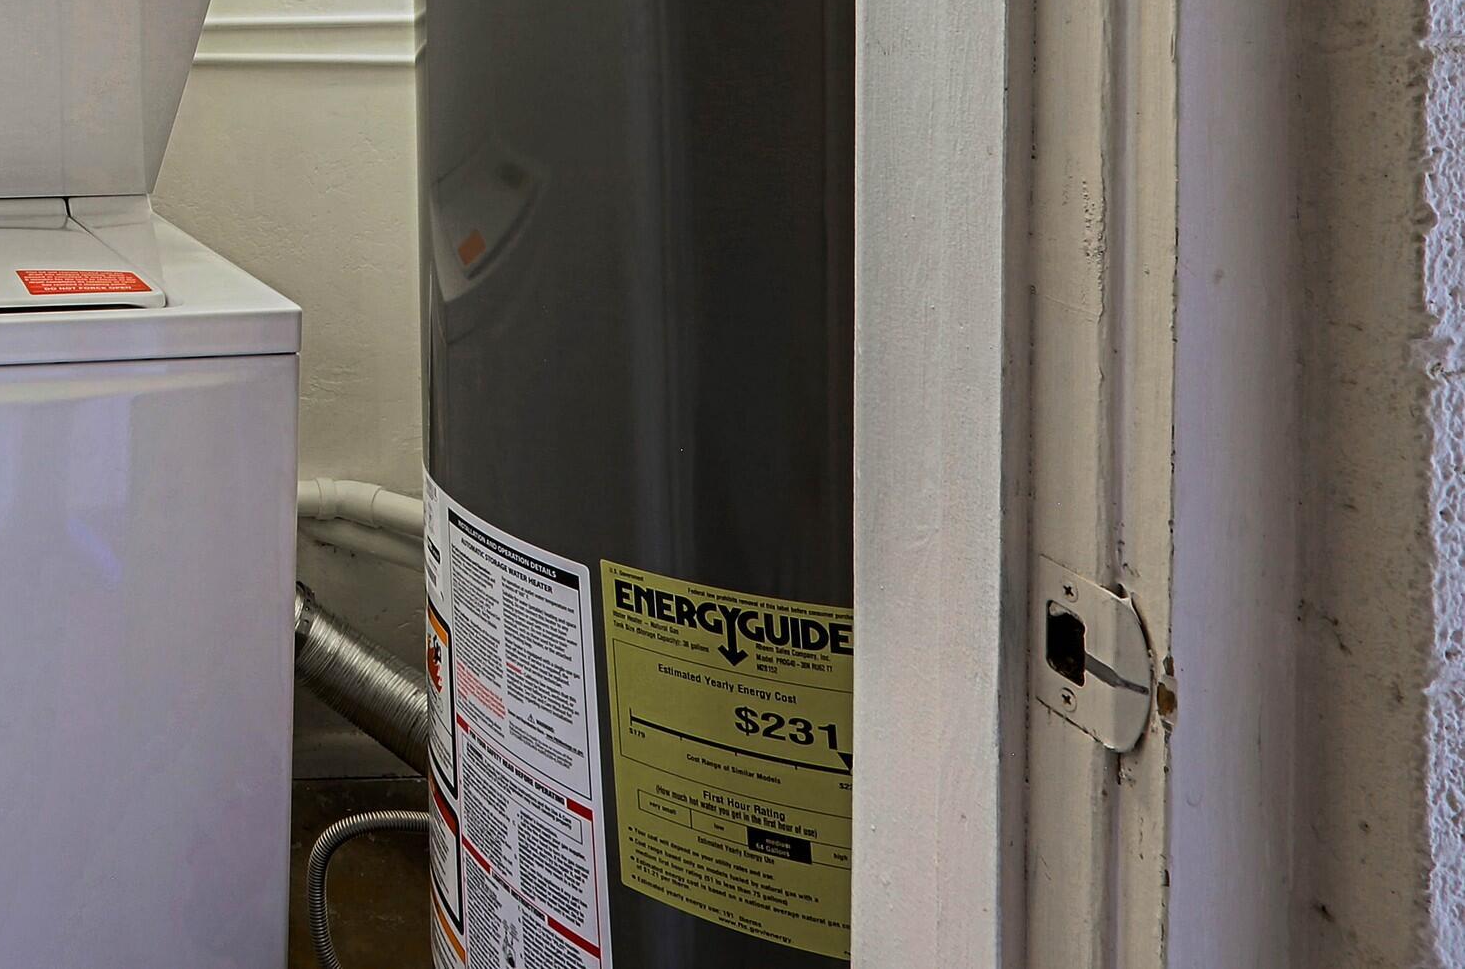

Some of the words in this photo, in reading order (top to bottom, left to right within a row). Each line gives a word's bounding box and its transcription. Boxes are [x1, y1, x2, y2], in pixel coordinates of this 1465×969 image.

[485, 552, 508, 572] STORAGE
[508, 565, 528, 583] WATER
[528, 577, 553, 594] HEATER
[498, 545, 530, 567] OPERATION
[530, 561, 557, 579] DETAILS
[614, 578, 854, 659] ENERGYGUIDE
[658, 663, 702, 684] Estimated
[704, 675, 734, 693] Yearly
[738, 683, 772, 701] Energy
[775, 692, 797, 705] Cost
[734, 705, 839, 751] $231
[686, 753, 700, 763] Cost
[702, 758, 722, 769] Range
[731, 767, 755, 778] Similar
[756, 773, 782, 784] Models
[656, 785, 670, 797] (How
[672, 791, 688, 803] much
[689, 796, 699, 807] hot
[700, 801, 717, 811] water
[719, 807, 730, 816] you
[752, 815, 762, 825] the
[763, 817, 776, 828] first
[778, 821, 793, 833] hour
[803, 829, 818, 839] use)
[703, 790, 724, 804] First
[727, 797, 750, 812] Hour
[754, 805, 786, 822] Rating
[833, 853, 848, 861] high
